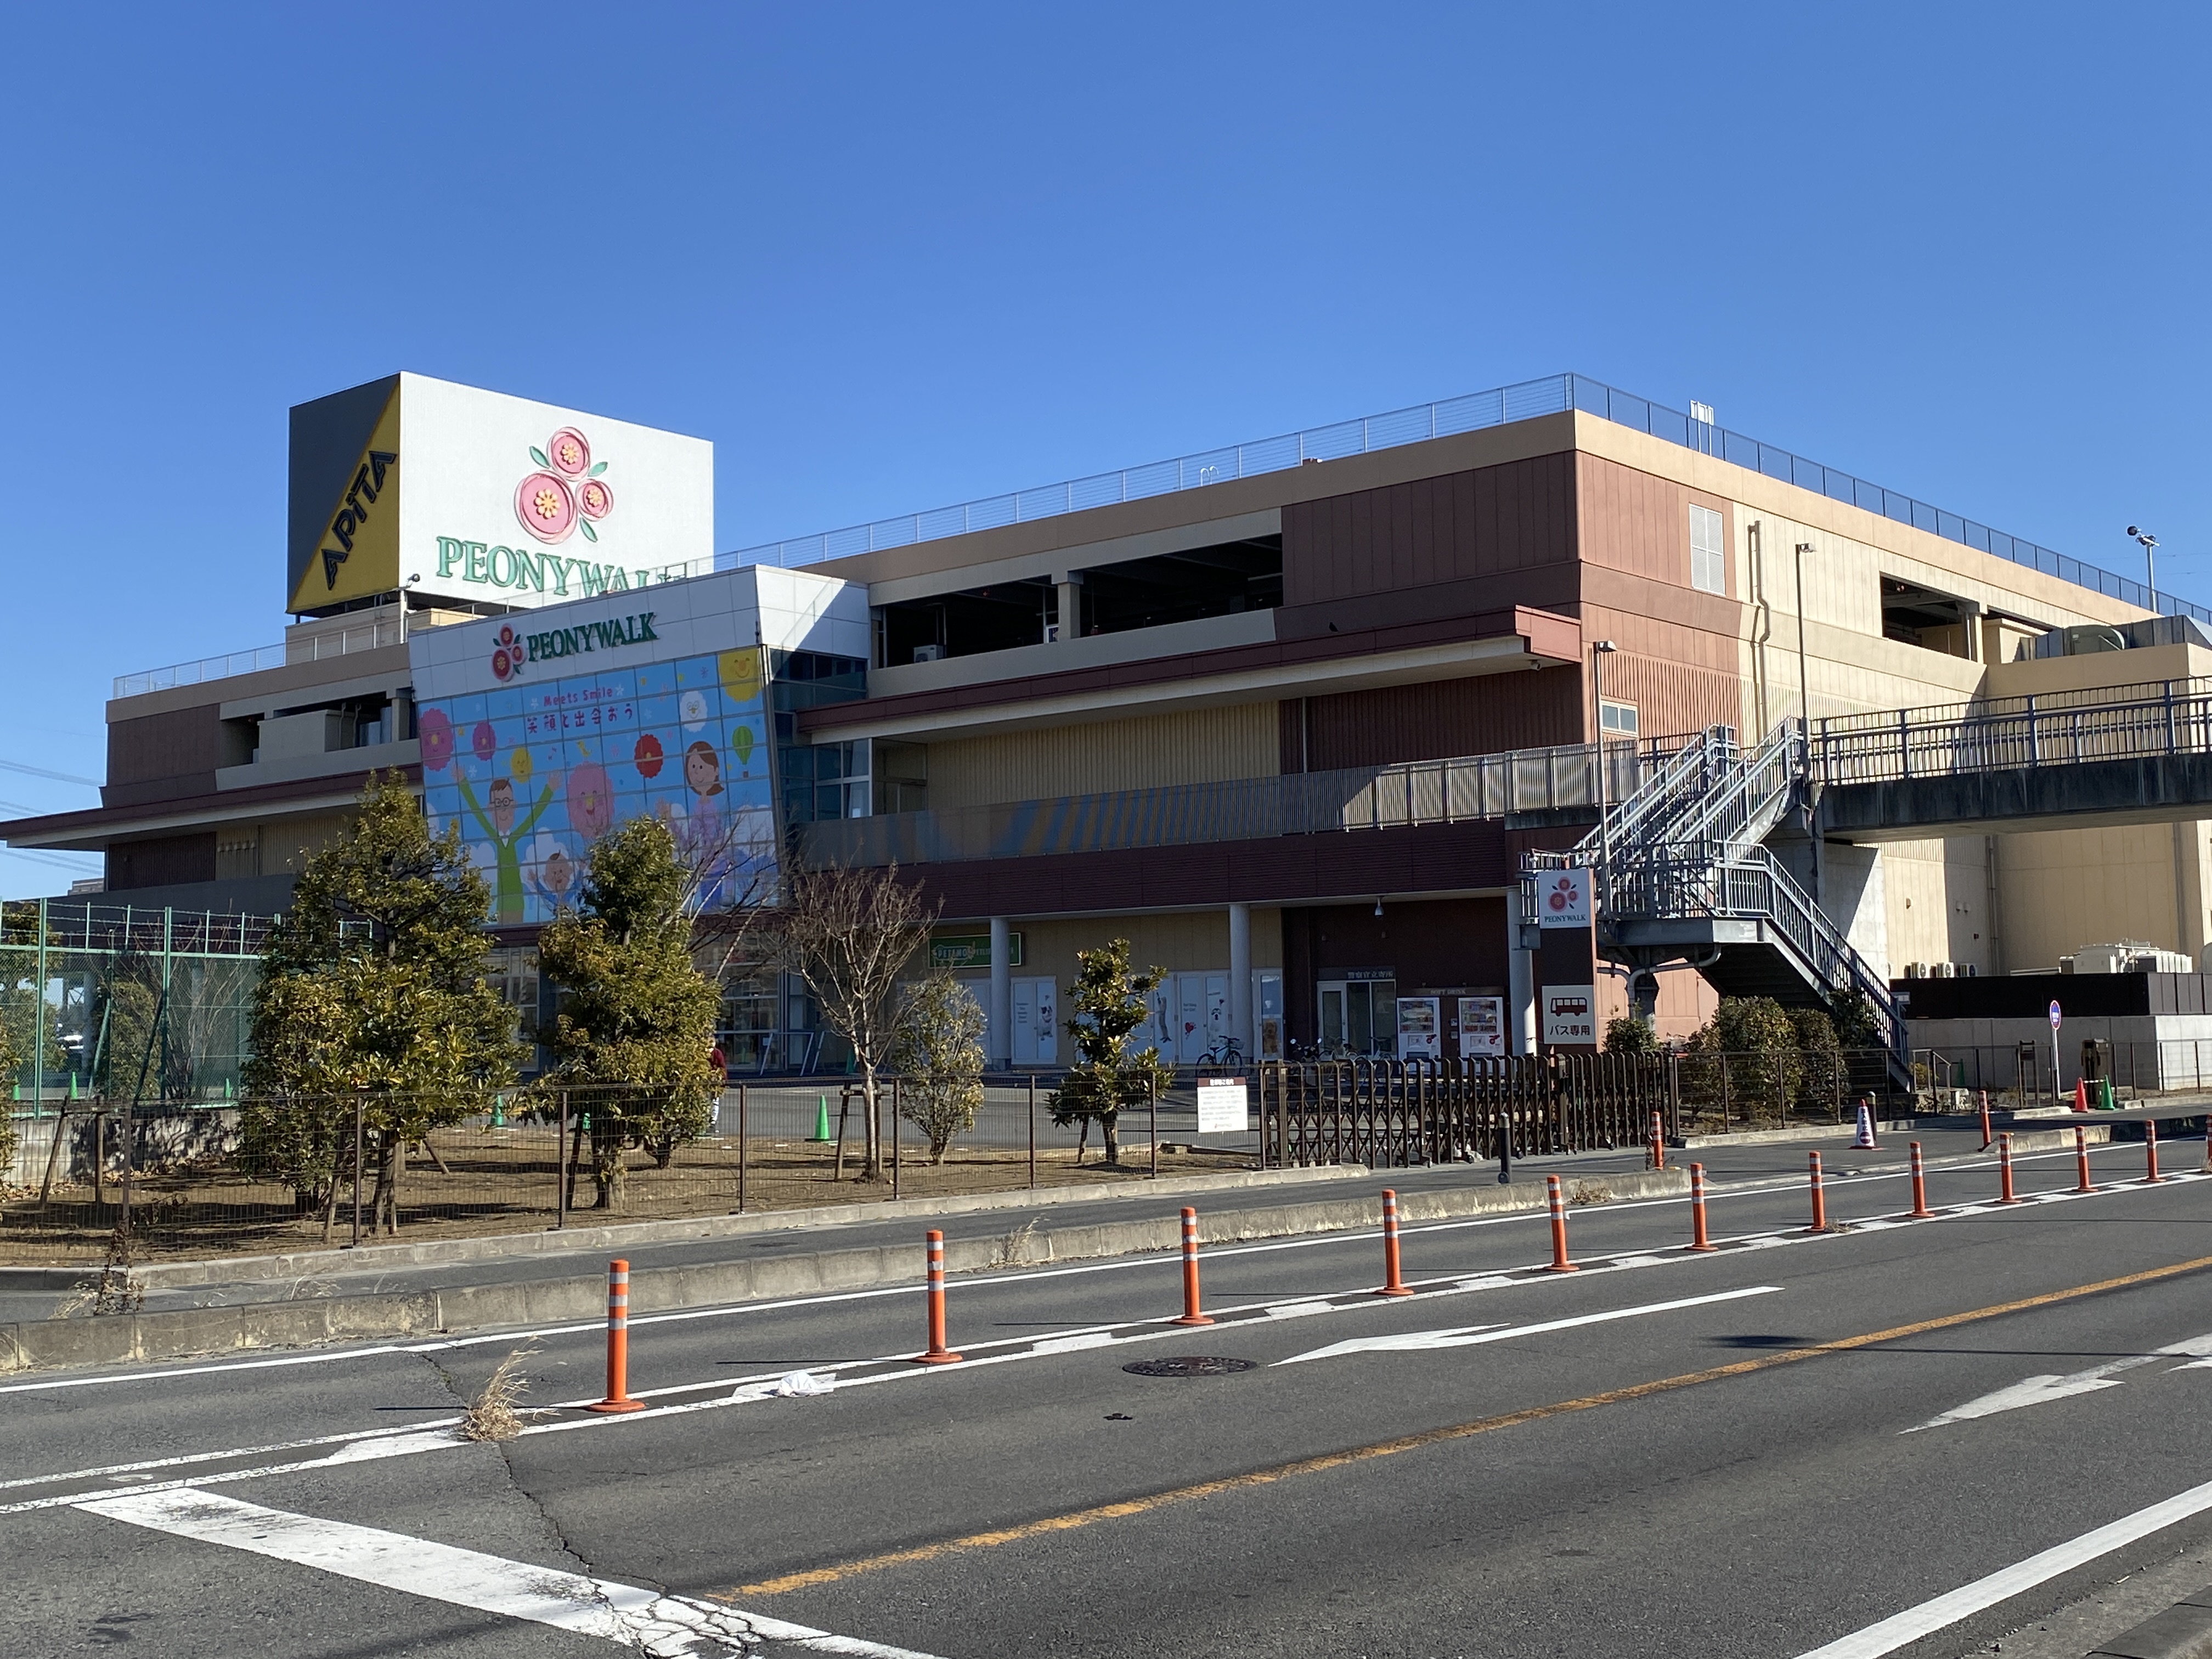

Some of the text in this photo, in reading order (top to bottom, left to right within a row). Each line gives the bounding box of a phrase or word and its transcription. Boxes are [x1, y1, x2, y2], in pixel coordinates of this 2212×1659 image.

[527, 612, 659, 662] PEONYWALK
[544, 687, 613, 707] Meets Smile
[527, 703, 633, 734] 笑顔と出会おう
[1544, 913, 1586, 922] PEONYWALK
[1550, 1025, 1590, 1036] バス専用
